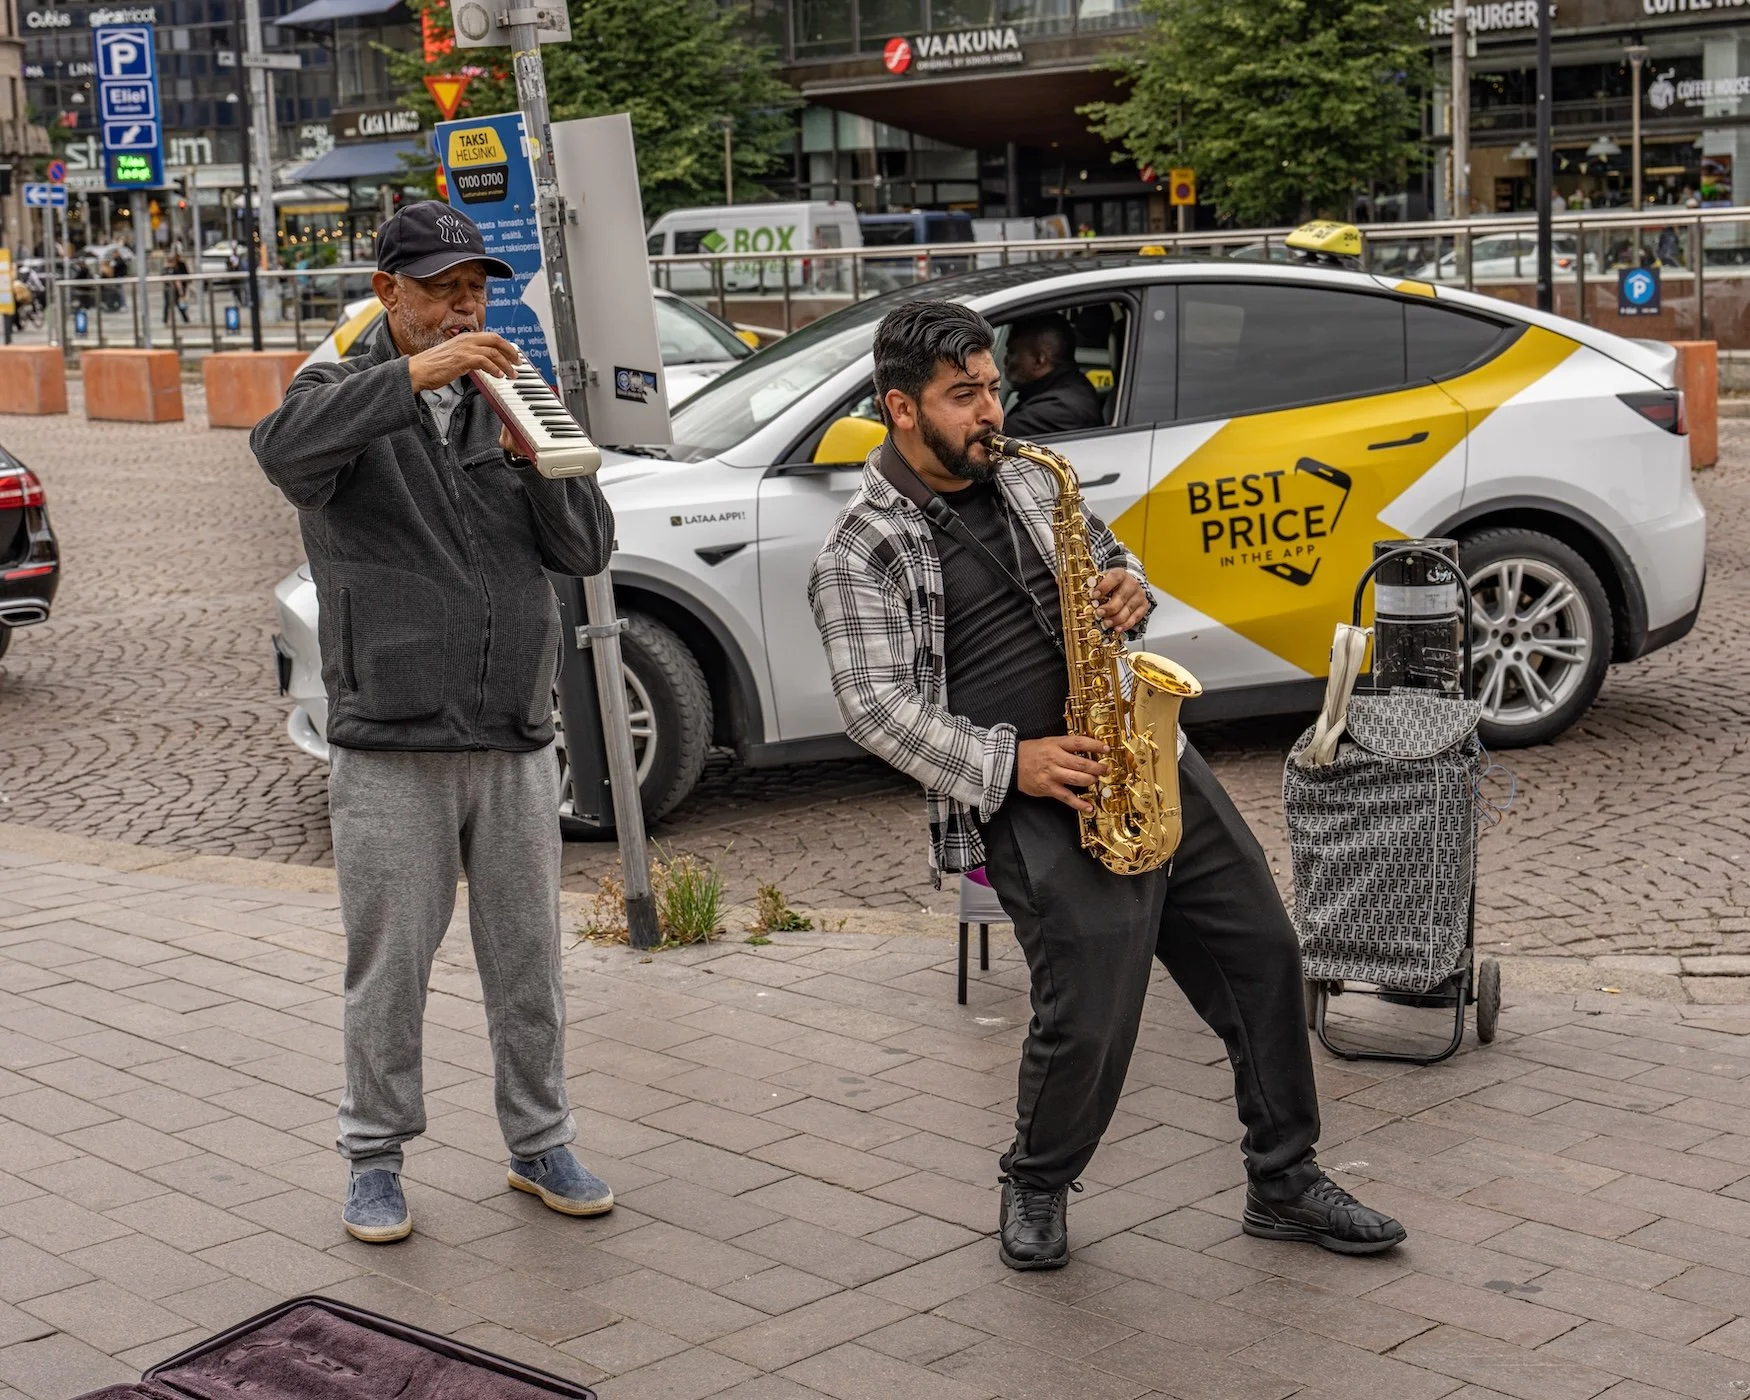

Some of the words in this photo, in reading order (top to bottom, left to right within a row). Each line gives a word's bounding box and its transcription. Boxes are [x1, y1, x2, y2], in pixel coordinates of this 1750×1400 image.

[26, 11, 71, 28] Cubus
[915, 27, 1019, 57] VAAKUNA
[110, 43, 138, 77] P
[110, 88, 146, 104] Eliel
[1676, 80, 1714, 100] COFFEE
[459, 132, 489, 147] TAKSI
[455, 146, 497, 162] HELSINKI
[458, 174, 481, 189] 0100
[481, 171, 504, 187] 0700
[734, 224, 797, 253] BOX
[1187, 470, 1285, 516] BEST
[684, 514, 718, 525] LATAA
[1202, 505, 1327, 553] PRICE
[1220, 555, 1235, 568] IN
[1240, 550, 1274, 565] THE
[1283, 544, 1316, 559] APP
